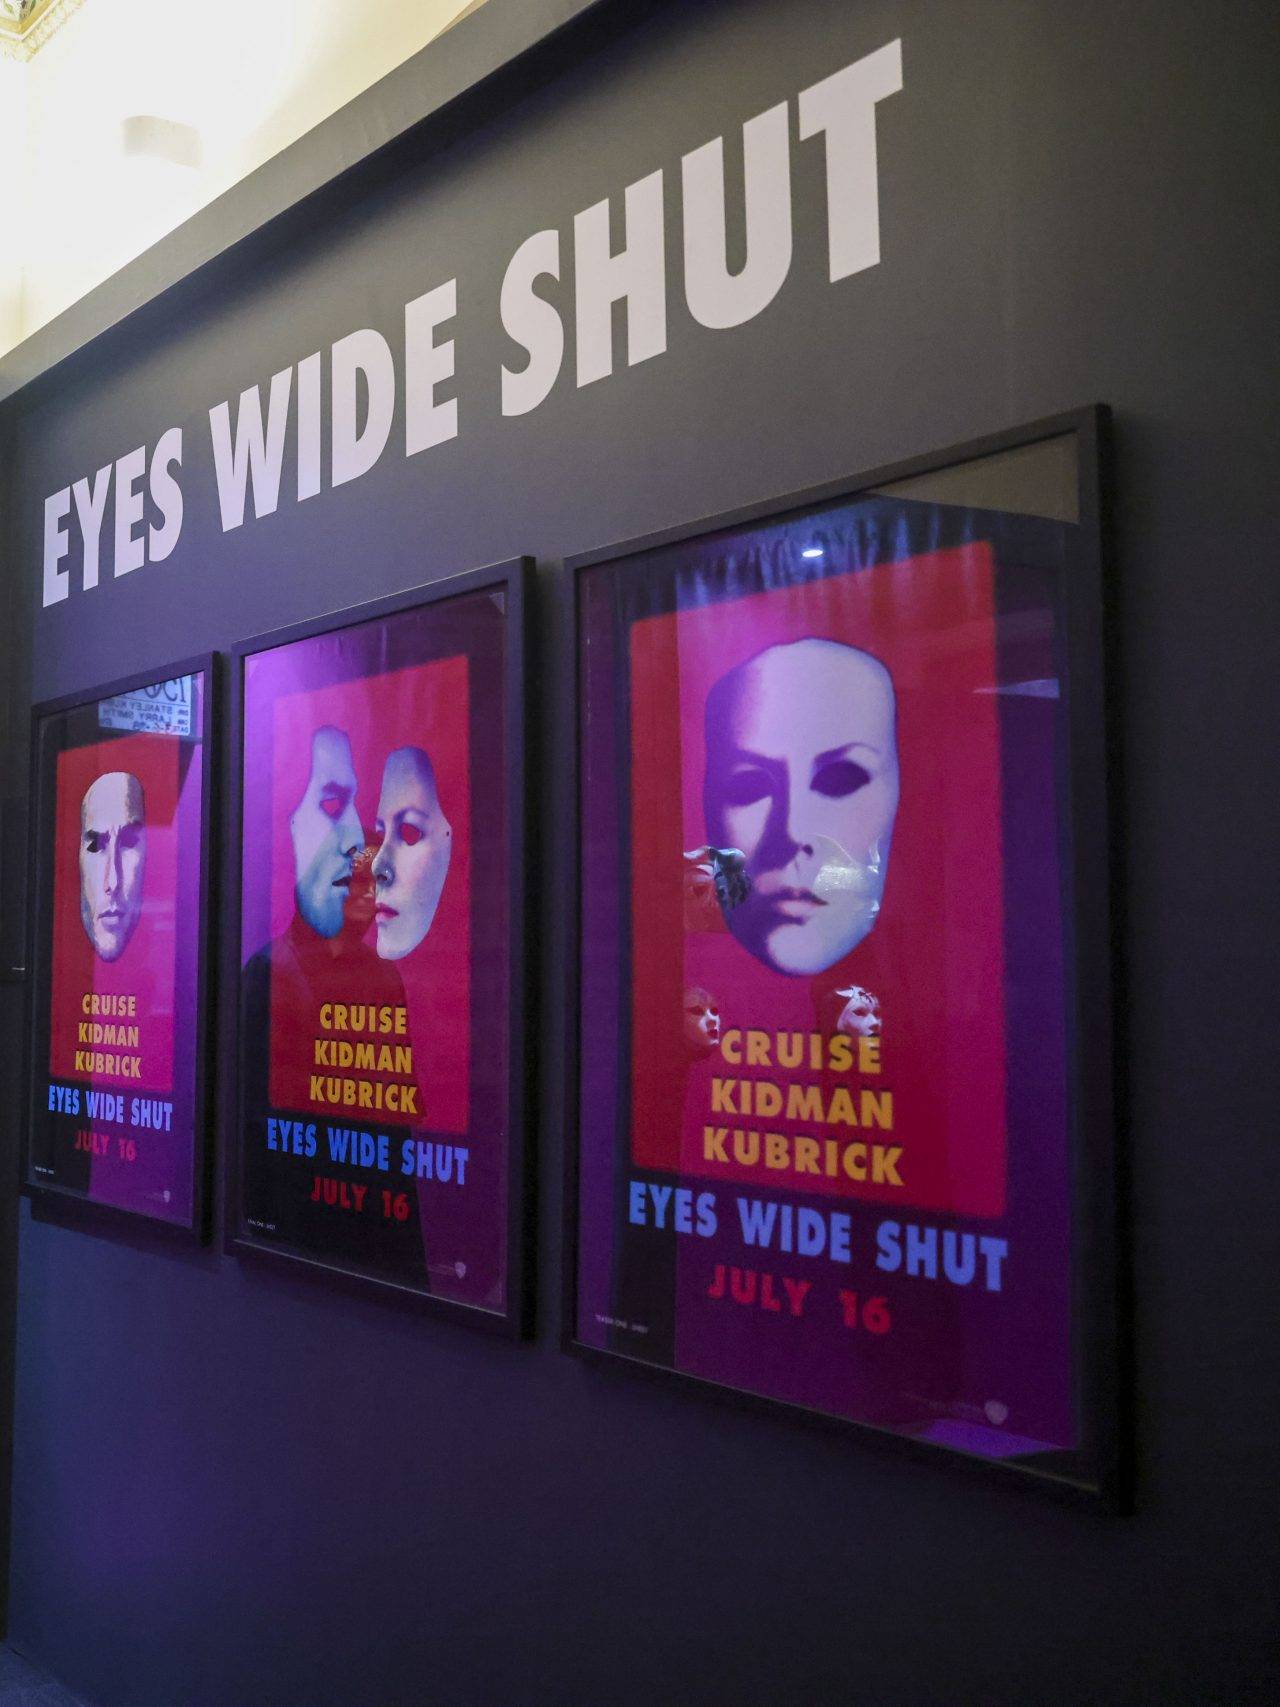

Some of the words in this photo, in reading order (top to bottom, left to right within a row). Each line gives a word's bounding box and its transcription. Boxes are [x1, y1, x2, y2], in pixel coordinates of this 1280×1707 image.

[42, 427, 184, 608] EYES
[208, 277, 459, 533] WIDE
[499, 37, 904, 417] SHUT
[81, 994, 137, 1017] CRUISE
[320, 1004, 408, 1035] CRUISE
[78, 1023, 139, 1048] KIDMAN
[314, 1040, 413, 1074] KIDMAN
[721, 1029, 881, 1074] CRUISE
[75, 1051, 142, 1079] KUBRICK
[48, 1085, 80, 1116] EYES
[86, 1091, 124, 1124] WIDE
[131, 1098, 173, 1131] SHUT
[310, 1075, 418, 1114] KUBRICK
[710, 1078, 894, 1130] KIDMAN
[75, 1130, 110, 1154] JULY
[120, 1137, 137, 1161] 16
[267, 1118, 318, 1158] EYES
[327, 1127, 390, 1172] WIDE
[401, 1139, 469, 1185] SHUT
[703, 1126, 905, 1186] KUBRICK
[311, 1177, 368, 1212] JULY
[382, 1190, 411, 1221] 16
[628, 1180, 718, 1238] EYES
[736, 1197, 852, 1264] WIDE
[876, 1221, 1008, 1292] SHUT
[708, 1265, 814, 1317] JULY
[840, 1290, 892, 1335] 16
